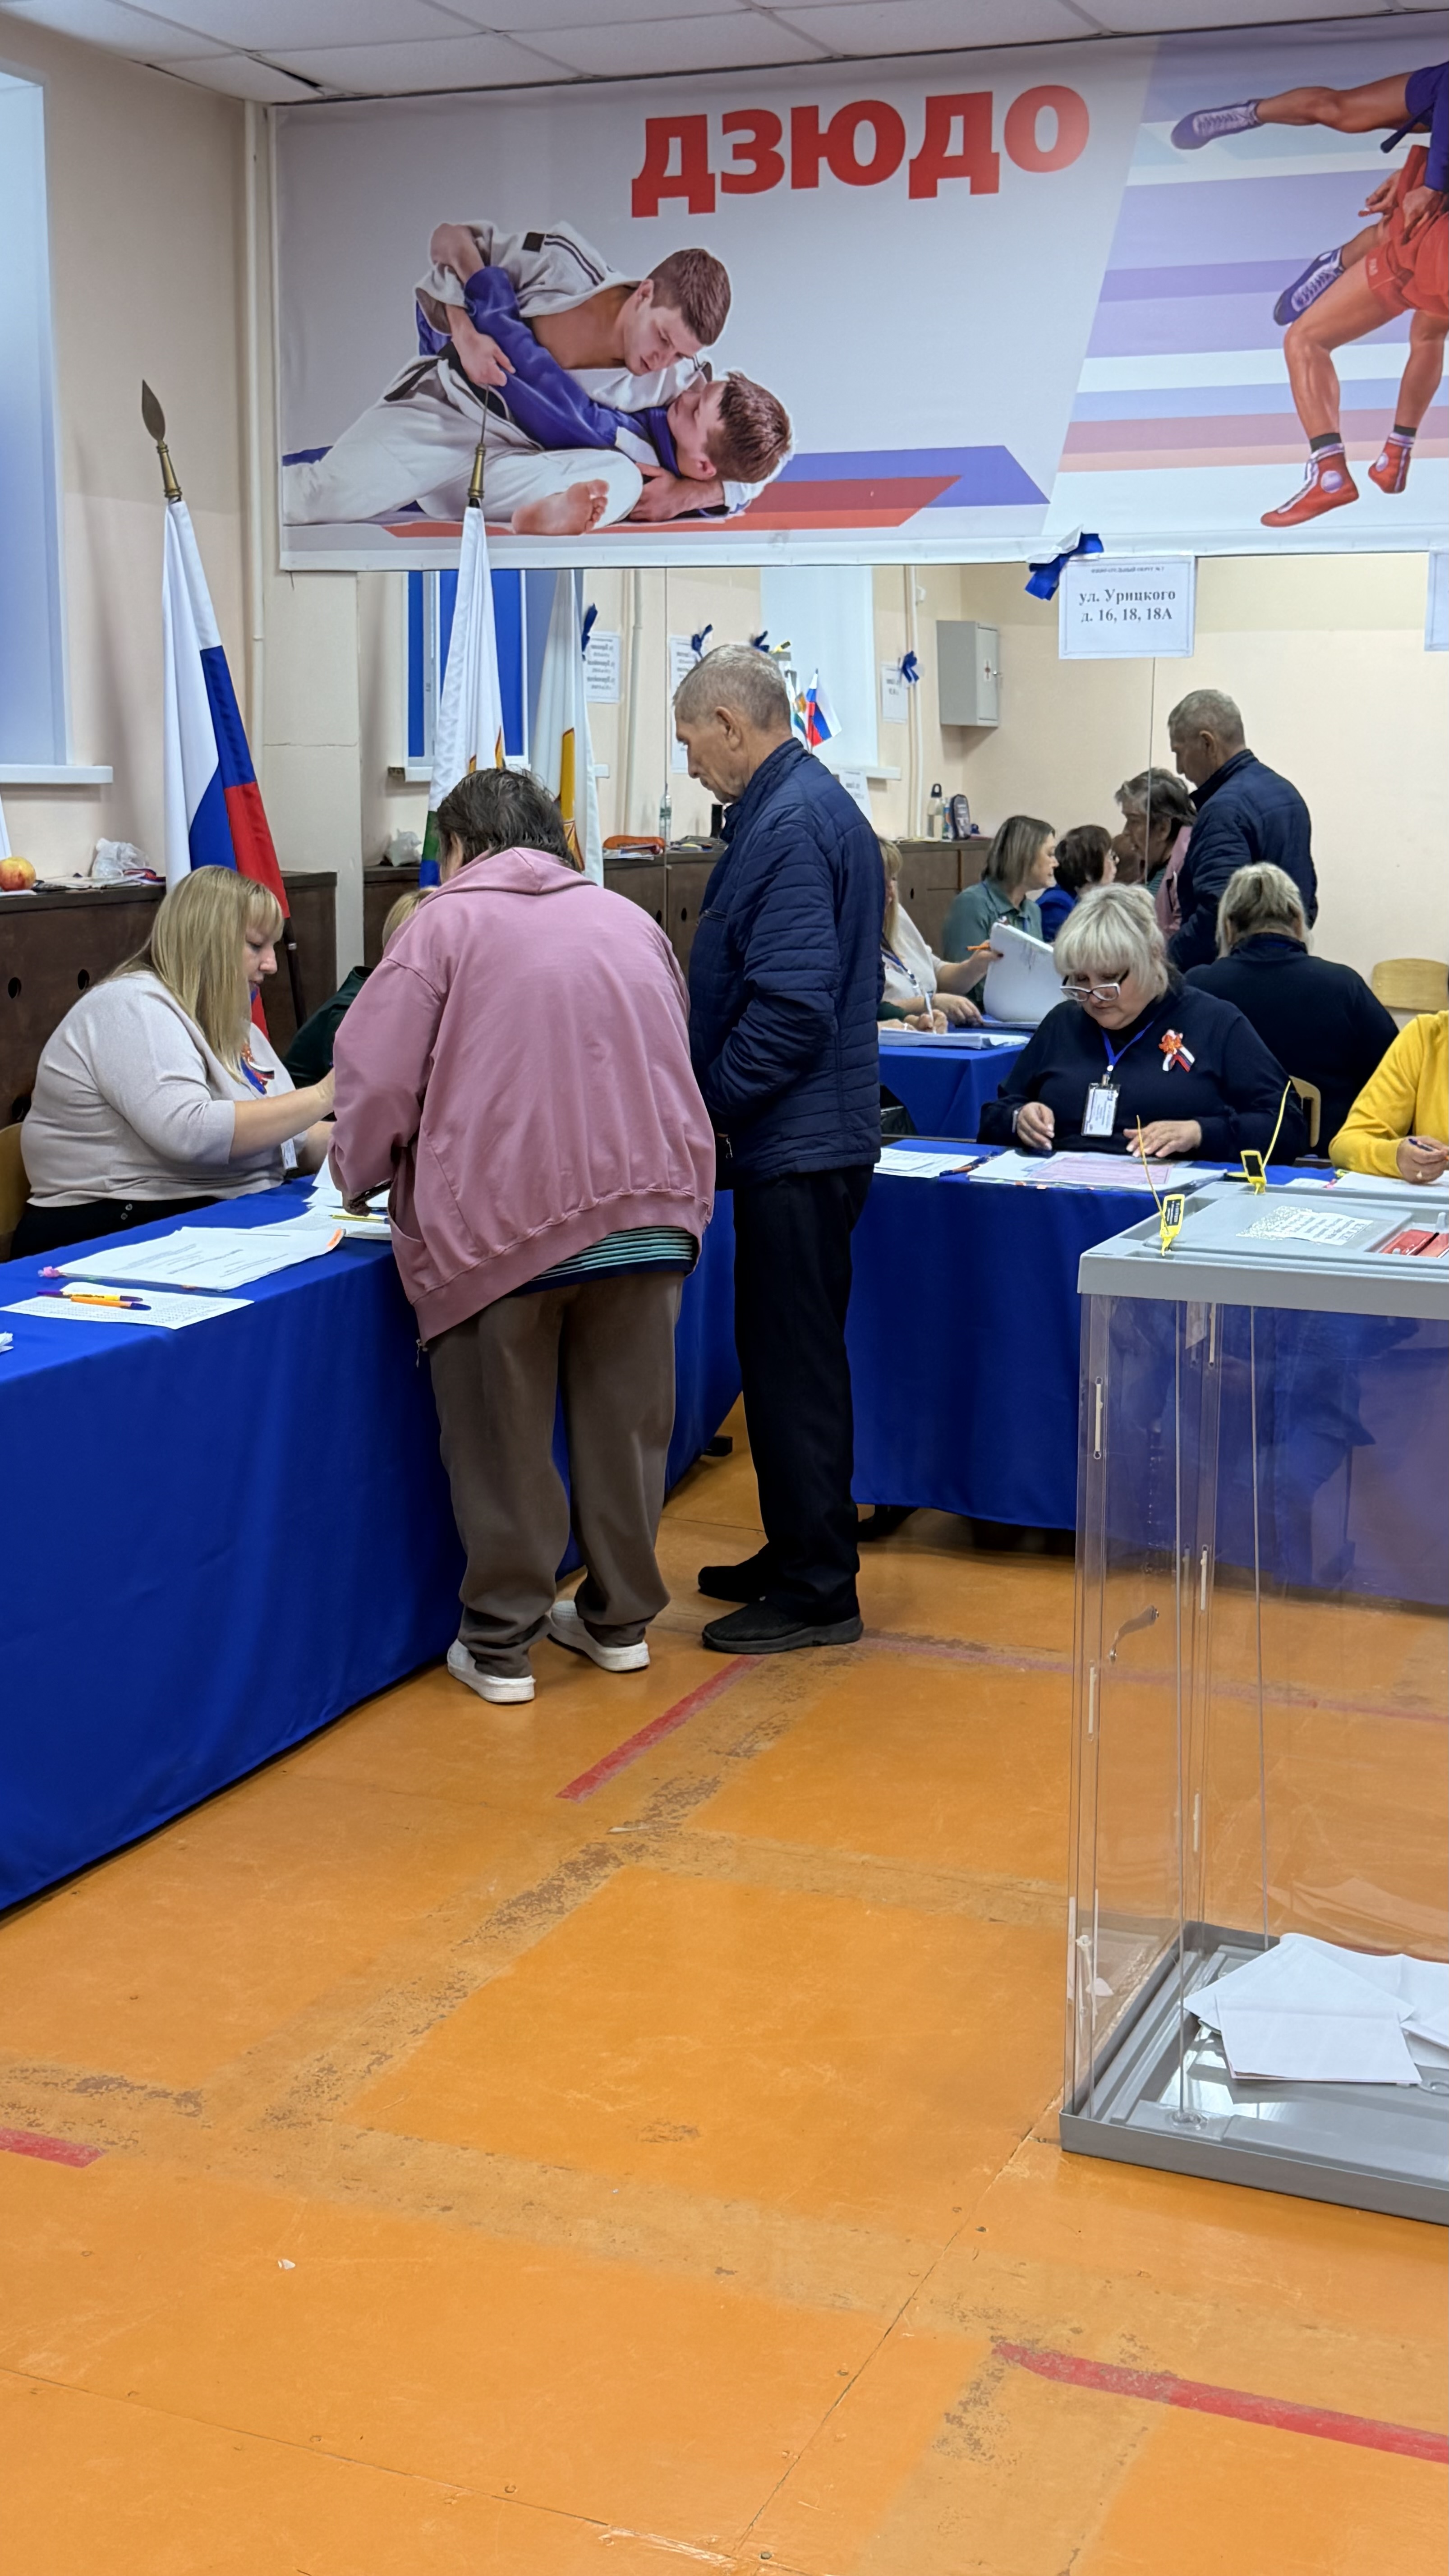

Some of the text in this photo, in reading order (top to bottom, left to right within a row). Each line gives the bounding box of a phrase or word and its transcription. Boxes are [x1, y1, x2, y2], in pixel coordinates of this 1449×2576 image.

[631, 84, 1090, 217] ДЗЮДО
[1079, 589, 1176, 606] ул. Урицкого
[1081, 607, 1173, 623] д. 16, 18, 18А
